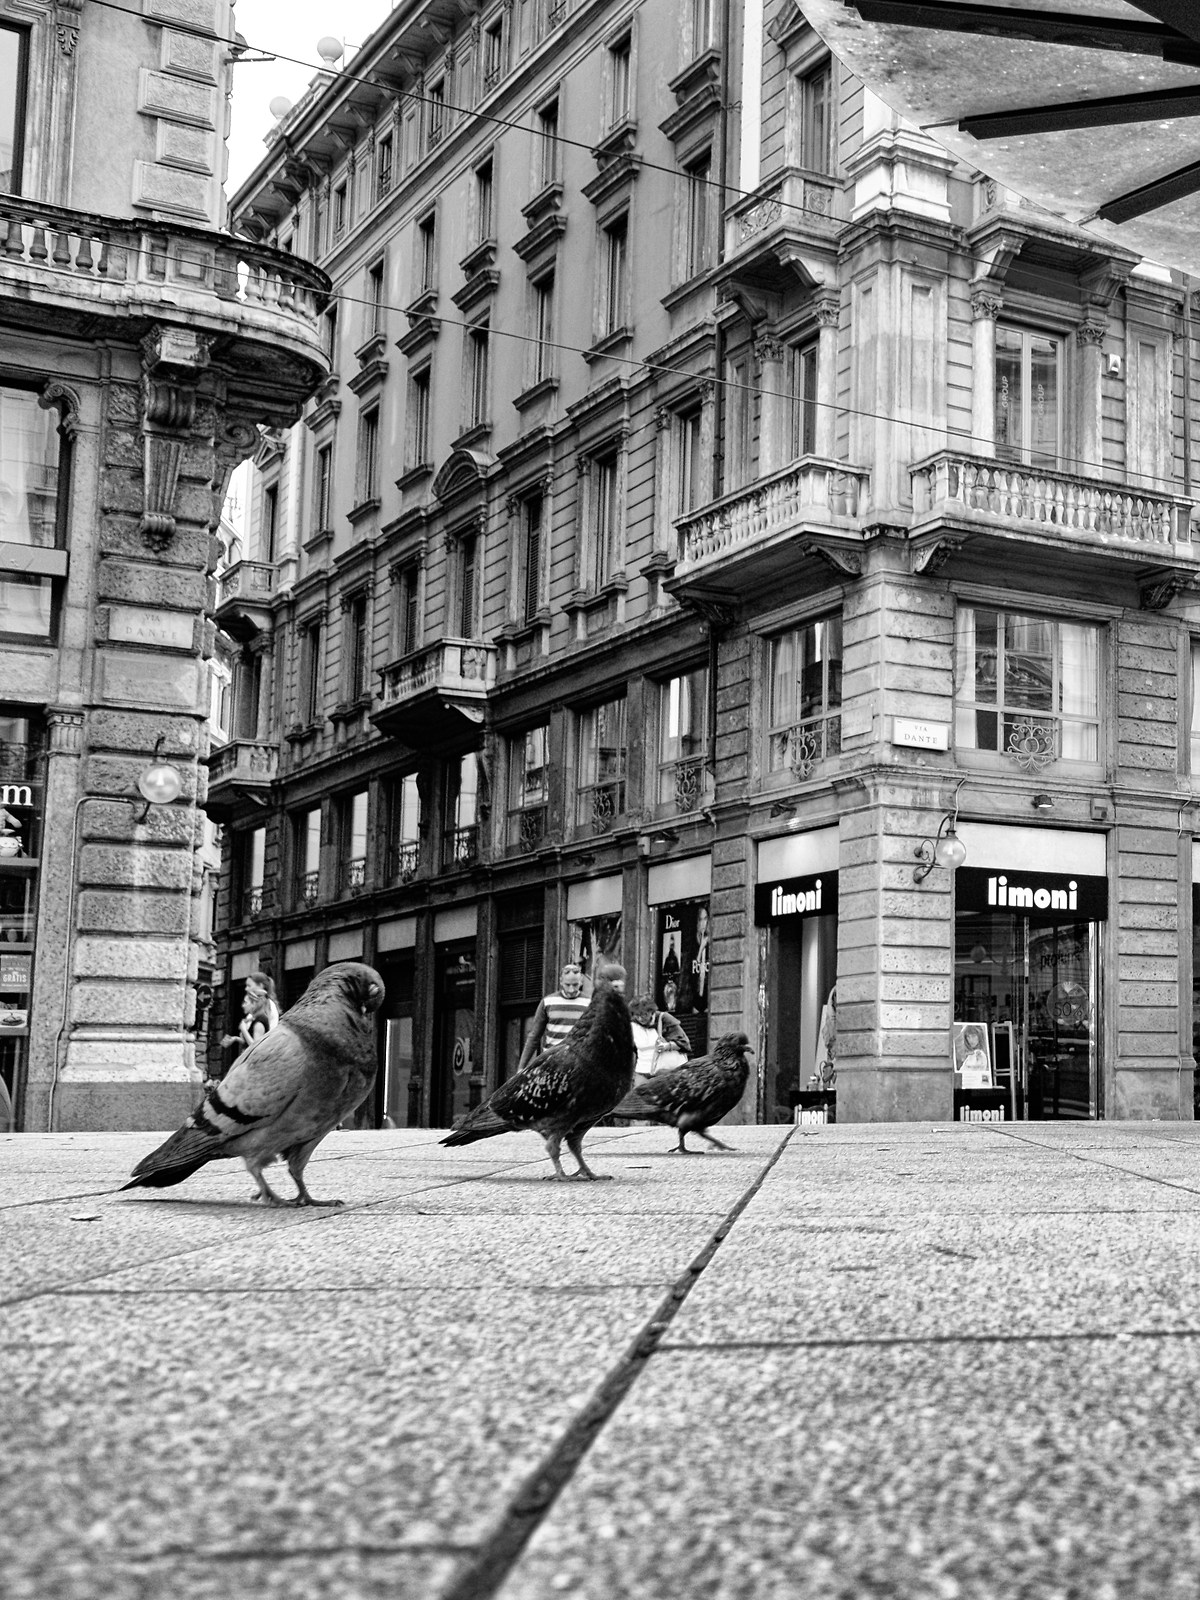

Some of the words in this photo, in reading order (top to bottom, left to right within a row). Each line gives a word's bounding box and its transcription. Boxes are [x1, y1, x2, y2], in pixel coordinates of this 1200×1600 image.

[145, 613, 160, 622] VIA
[125, 626, 178, 641] DANTE
[904, 733, 938, 744] DANTE
[772, 879, 822, 917] limoni
[988, 875, 1078, 910] limoni
[665, 914, 680, 930] Dior
[2, 973, 27, 983] GRATIS
[794, 1103, 828, 1125] limoni
[960, 1105, 1004, 1122] limoni
